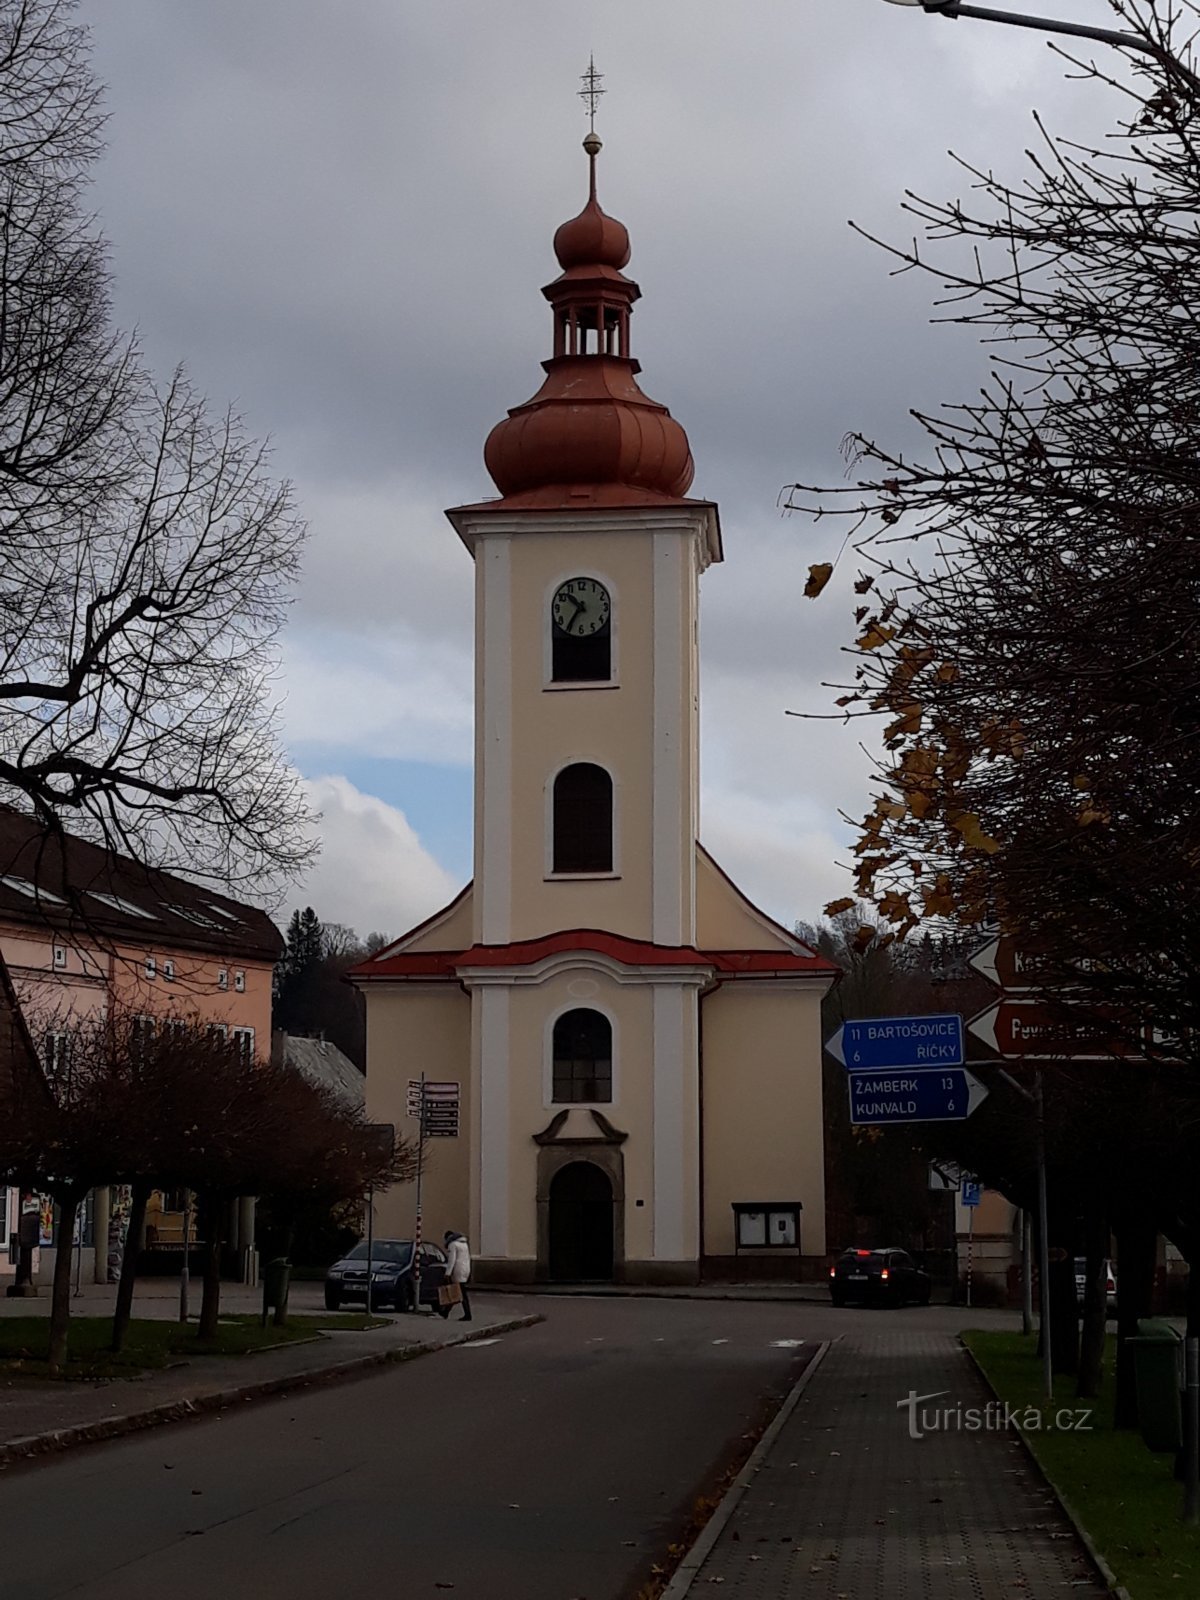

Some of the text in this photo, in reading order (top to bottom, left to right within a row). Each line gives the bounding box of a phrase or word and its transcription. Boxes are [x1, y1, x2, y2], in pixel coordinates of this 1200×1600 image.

[577, 582, 586, 591] 12
[851, 1023, 957, 1041] 11 BARTOŠOVICE
[853, 1050, 861, 1062] 6
[855, 1078, 953, 1095] ŽAMBERK 13
[856, 1099, 955, 1116] KUNVALD 6
